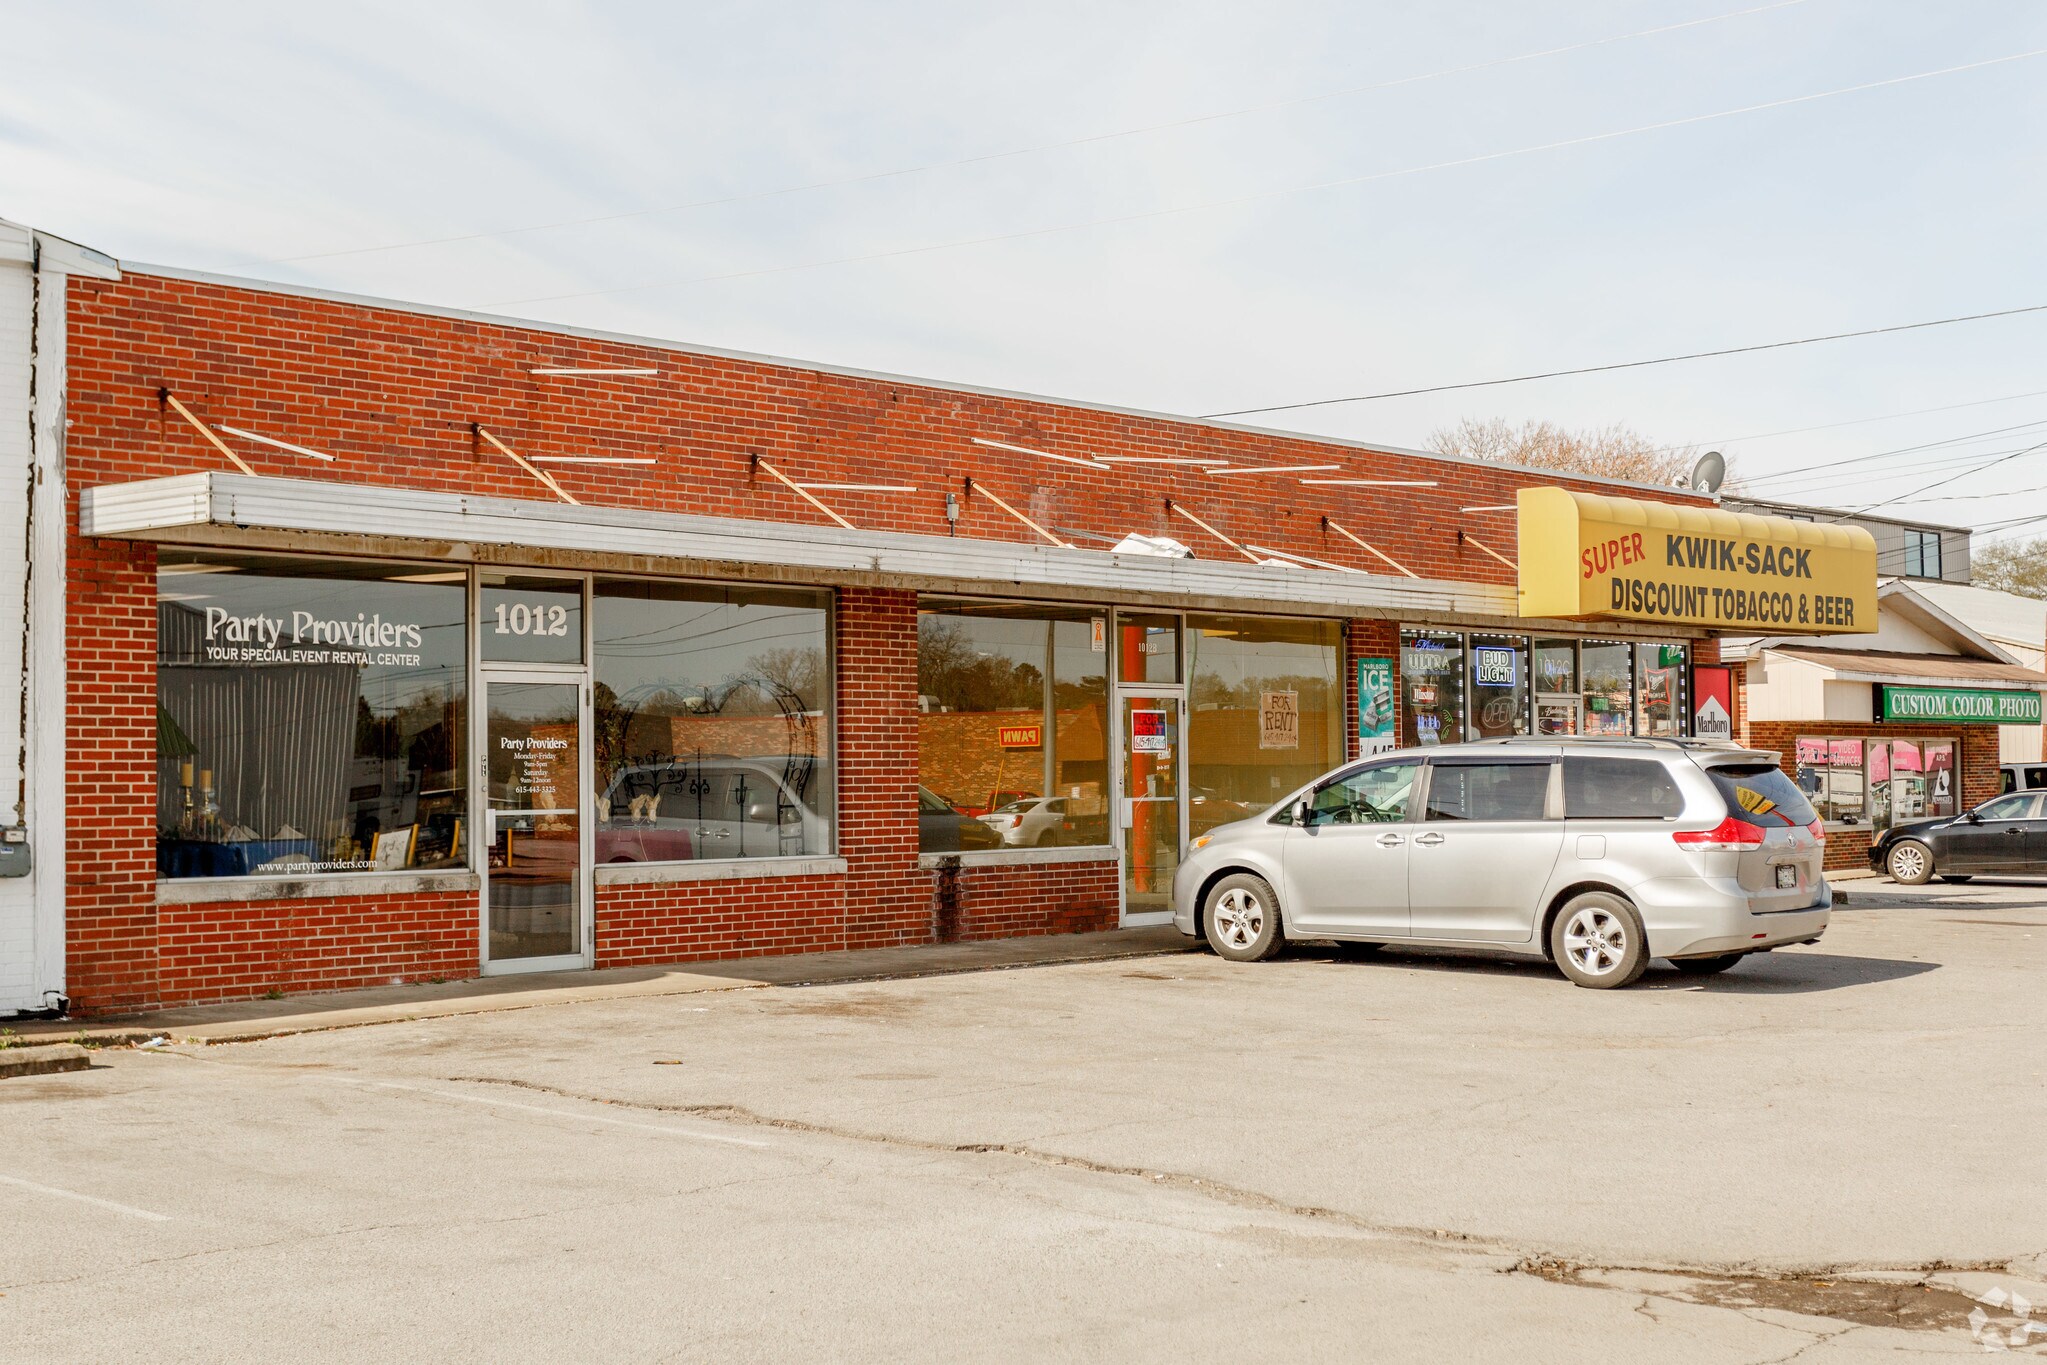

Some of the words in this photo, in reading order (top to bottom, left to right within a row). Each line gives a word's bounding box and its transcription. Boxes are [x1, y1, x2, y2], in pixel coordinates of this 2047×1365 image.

[1582, 533, 1645, 579] SUPER
[1667, 535, 1812, 579] KWIK-SACK
[1611, 578, 1708, 617] DISCOUNT
[1712, 588, 1793, 624] TOBACCO
[1798, 593, 1809, 624] &
[1815, 595, 1854, 626] BEER
[205, 607, 283, 649] Party
[292, 611, 421, 648] Providers
[494, 603, 568, 636] 1012
[206, 646, 239, 660] YOUR
[241, 648, 291, 662] SPECIAL
[293, 650, 330, 663] EVENT
[332, 651, 375, 665] RENTAL
[377, 653, 420, 666] CENTER
[1408, 653, 1451, 671] ULTRA
[1483, 650, 1508, 666] BUD
[1363, 670, 1390, 691] ICE
[1478, 666, 1513, 682] LIGHT
[1271, 695, 1291, 710] FOR
[1891, 694, 1947, 715] CUSTOM
[1952, 696, 1994, 716] COLOR
[1999, 698, 2040, 718] PHOTO
[1140, 714, 1159, 725] FOR
[1265, 711, 1297, 731] RENT
[1483, 702, 1516, 723] OPEN
[1697, 711, 1728, 733] Marlboro
[1135, 725, 1164, 735] RENT
[501, 737, 524, 750] Party
[527, 737, 568, 749] Providers
[1838, 744, 1856, 754] VIDEO
[1833, 757, 1861, 767] SERVICES
[523, 769, 549, 778] Saturday
[257, 859, 378, 874] www.partyproviders.com
